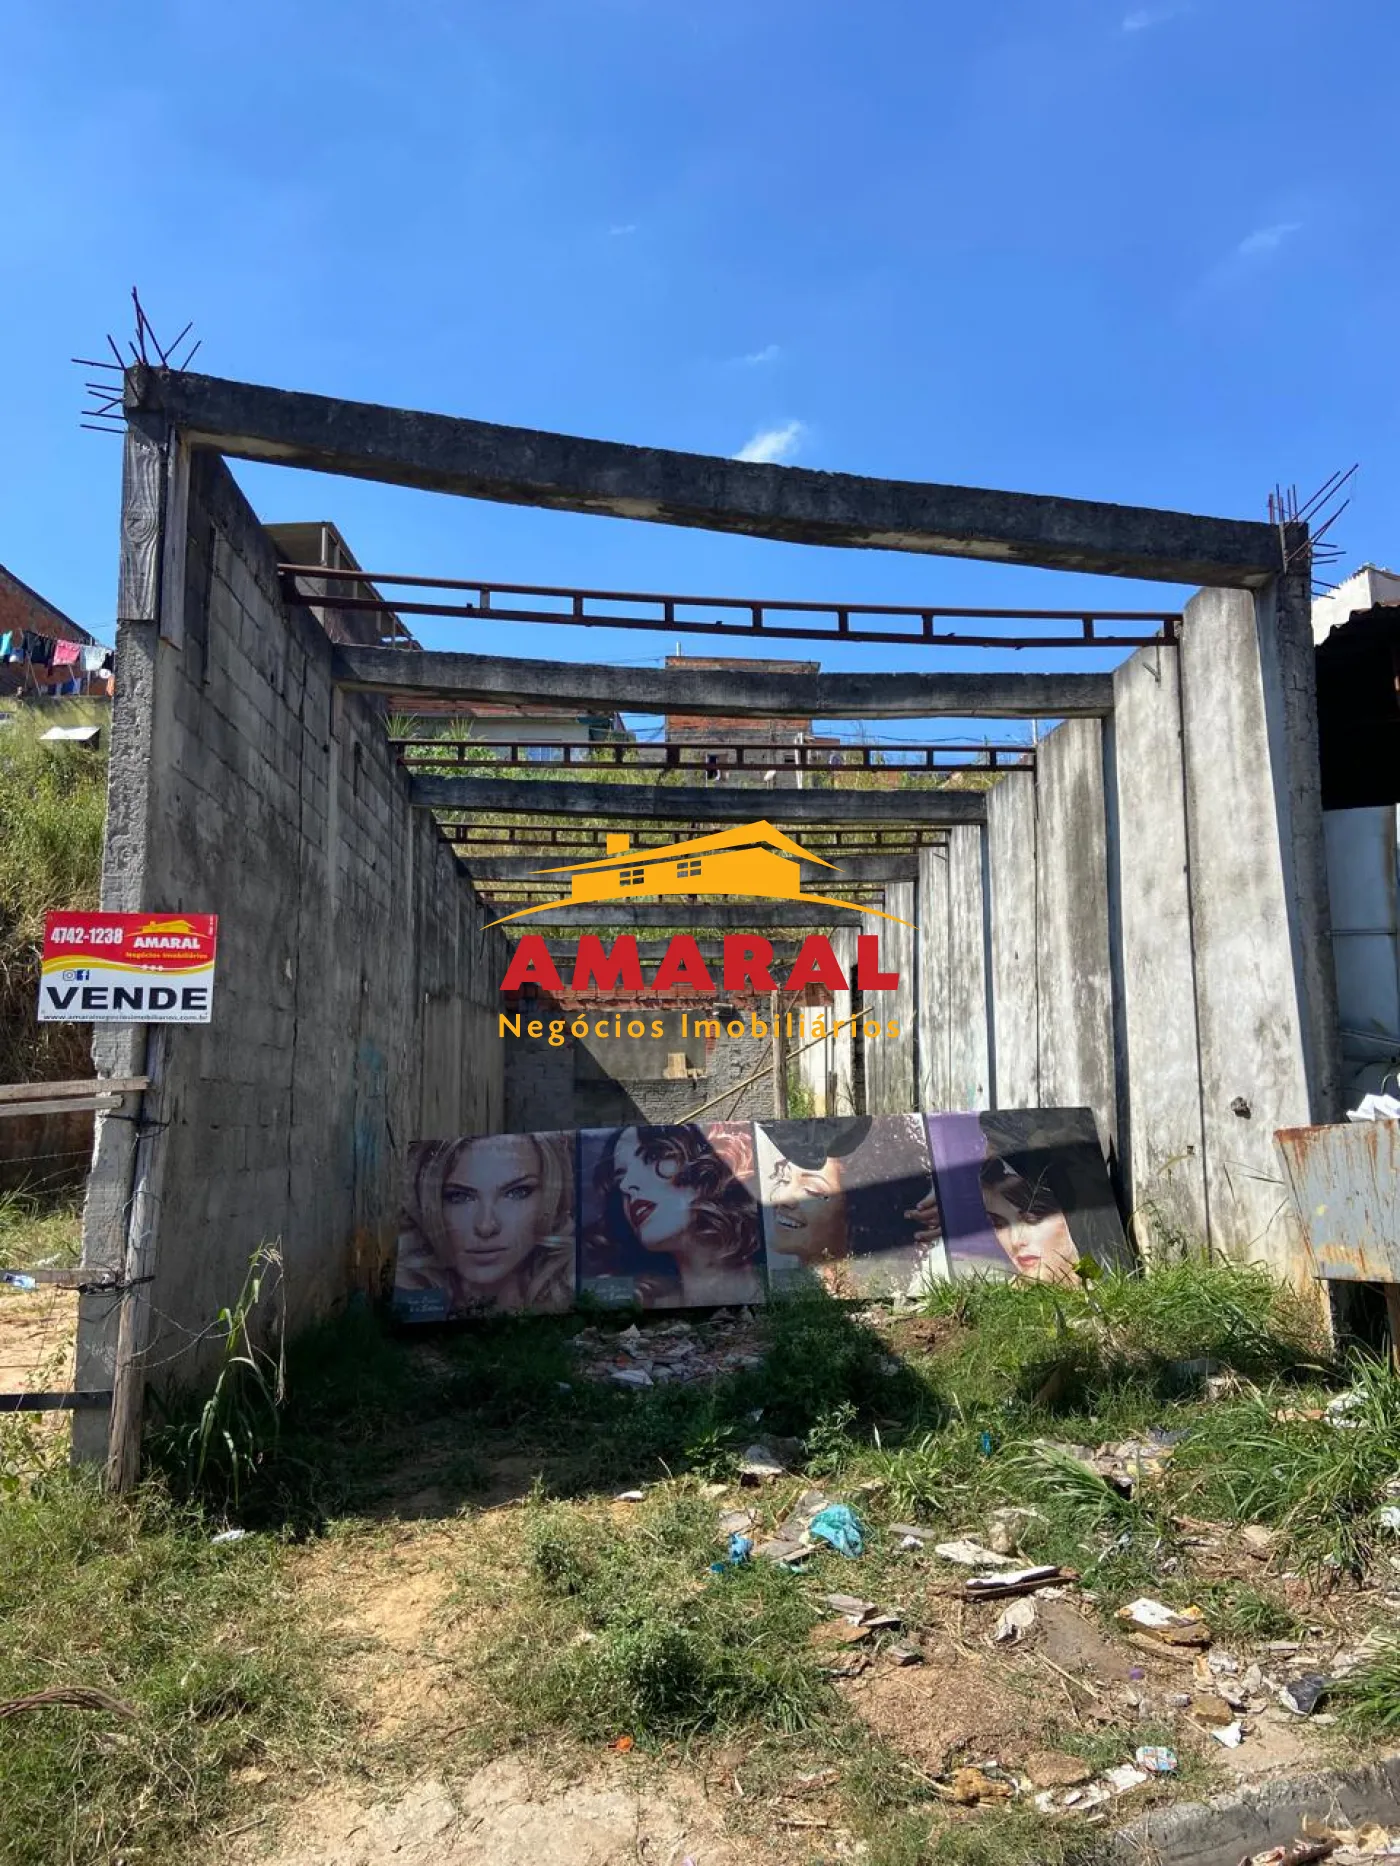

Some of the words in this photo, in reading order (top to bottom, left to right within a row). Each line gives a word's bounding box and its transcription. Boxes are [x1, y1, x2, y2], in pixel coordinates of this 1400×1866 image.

[51, 927, 123, 944] 4742-1238
[133, 936, 201, 949] AMARAL
[46, 986, 207, 1010] VENDE
